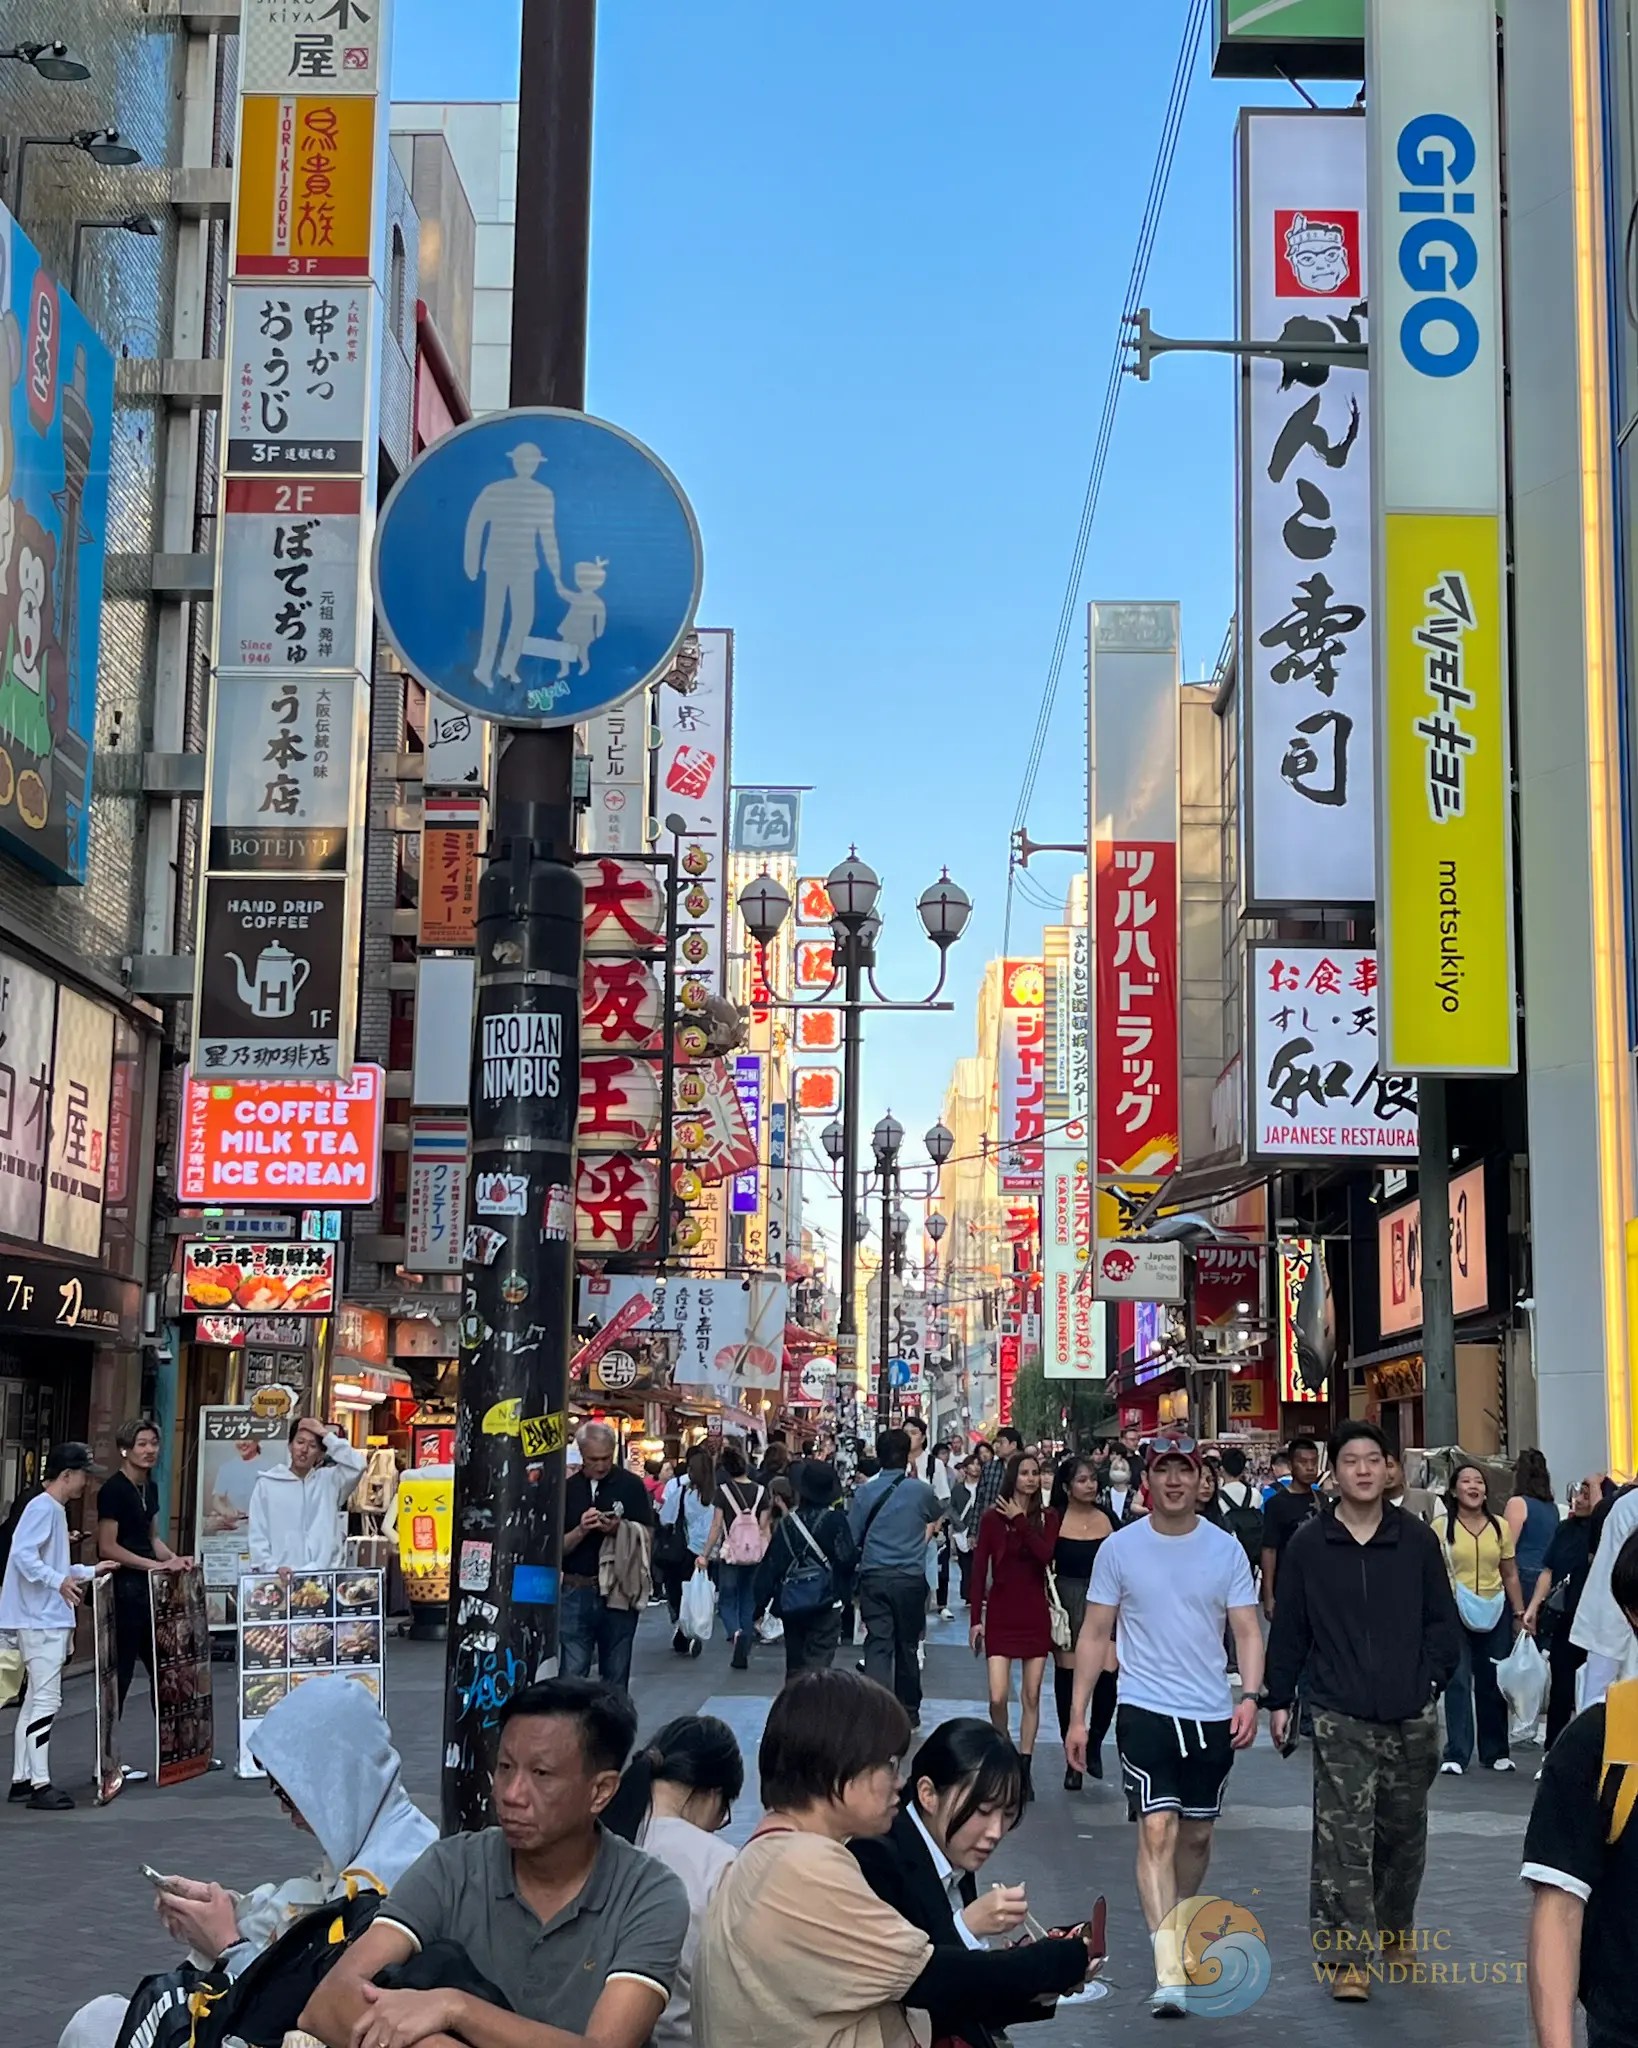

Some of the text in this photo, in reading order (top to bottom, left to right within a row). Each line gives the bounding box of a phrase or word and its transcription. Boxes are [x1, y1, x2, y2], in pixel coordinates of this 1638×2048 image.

[276, 105, 294, 240] TORIKIZOKU
[304, 299, 340, 400] 串かつ
[259, 299, 293, 434] おうじ
[251, 443, 281, 463] 3F
[274, 485, 316, 512] 2F
[318, 591, 336, 658] 元祖 発祥
[240, 639, 273, 652] Since
[241, 652, 271, 664] 1946
[1416, 573, 1476, 821] マツモトキヨシ
[313, 688, 332, 779] 大阪伝統の味
[440, 832, 460, 922] ミティラー
[227, 900, 325, 914] HAND DRIP
[241, 915, 309, 929] COFFEE
[1435, 860, 1466, 1014] matsukiyo
[1112, 849, 1161, 1134] ツルハドラッグ
[309, 1009, 332, 1029] 1F
[485, 1016, 560, 1057] TROJAN
[204, 1043, 334, 1070] 星乃珈琲店
[483, 1058, 560, 1100] NIMBUS
[234, 1100, 350, 1126] COFFEE
[220, 1130, 360, 1156] MILK TEA
[1264, 1126, 1419, 1148] JAPANESE RESTAURA
[211, 1161, 367, 1187] ICE CREAM
[431, 1164, 448, 1242] クンテープ
[1056, 1177, 1068, 1244] KARAOKE
[1143, 1262, 1177, 1272] Tax-free
[1147, 1252, 1176, 1262] Japan
[1198, 1248, 1258, 1270] ツルハ
[1155, 1272, 1177, 1282] Shop
[1199, 1271, 1246, 1286] ドラッグ
[6, 1275, 34, 1312] 7F
[1057, 1274, 1069, 1363] MANEKINEKO
[209, 1422, 282, 1439] マッサージ
